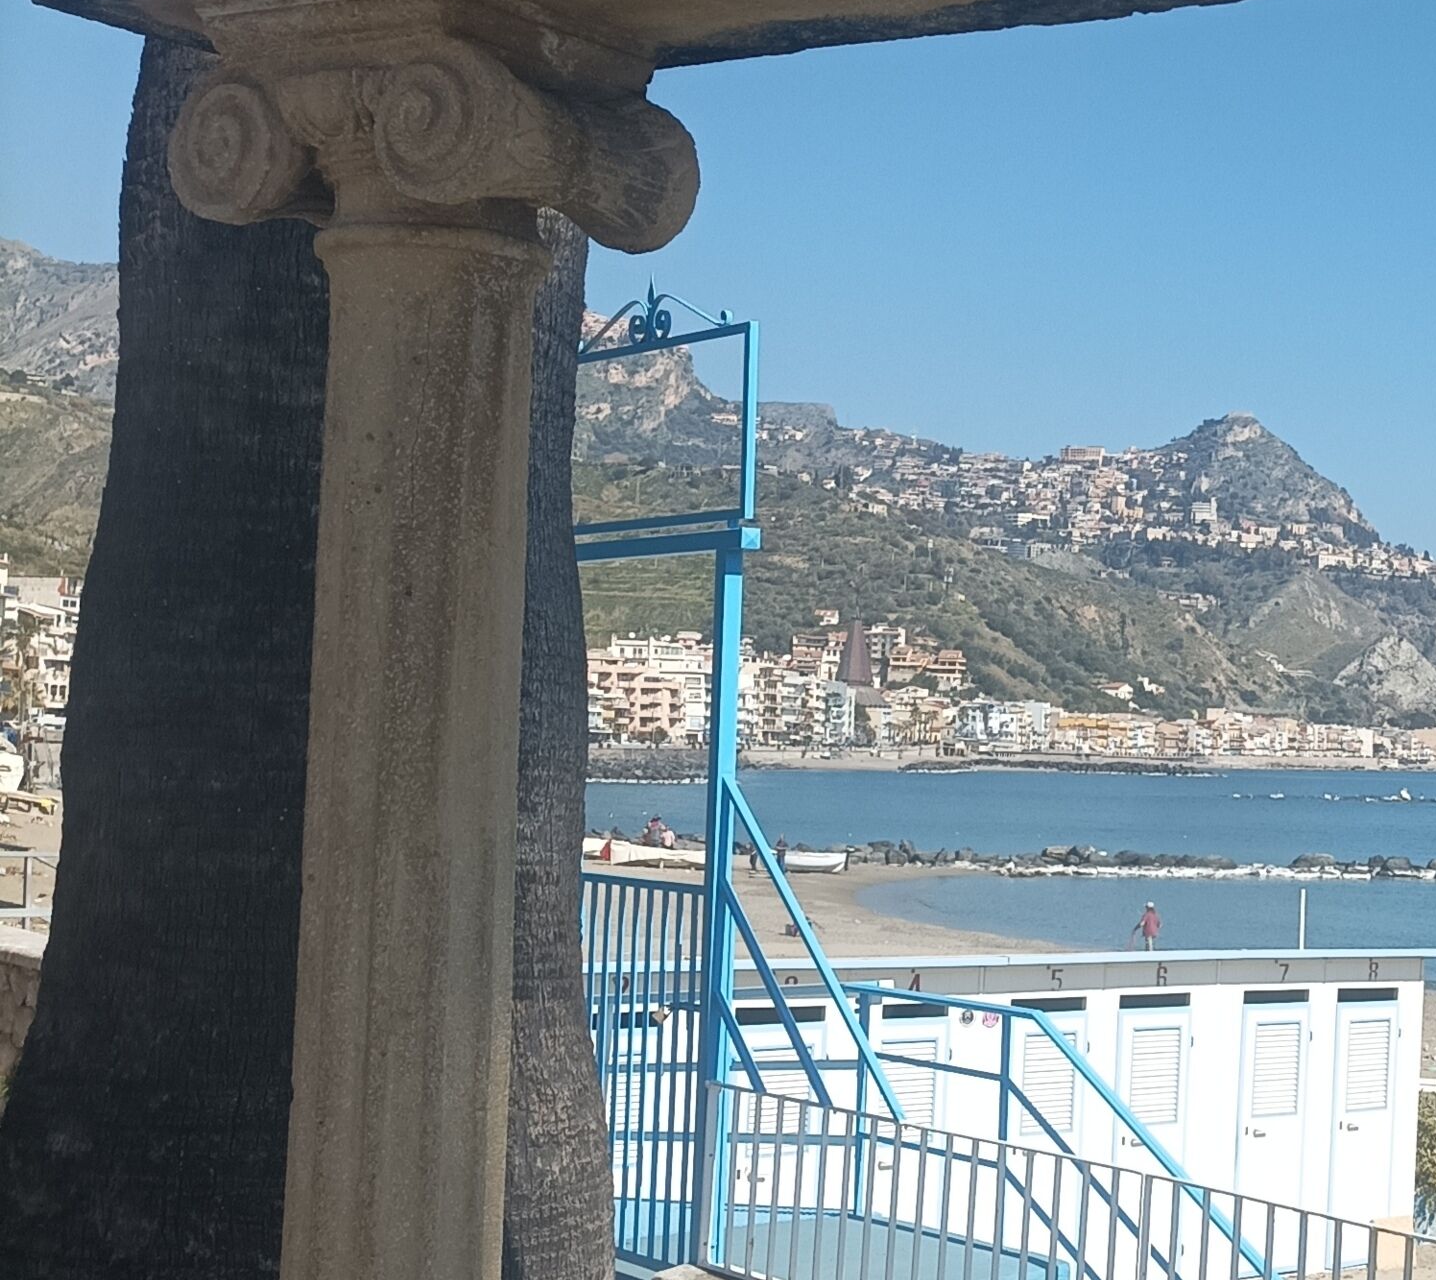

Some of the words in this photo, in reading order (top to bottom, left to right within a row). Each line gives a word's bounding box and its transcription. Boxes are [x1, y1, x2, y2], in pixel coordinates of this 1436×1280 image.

[1051, 968, 1064, 991] 5
[1156, 966, 1168, 987] 6
[1278, 963, 1290, 983] 7
[1369, 961, 1379, 980] 8
